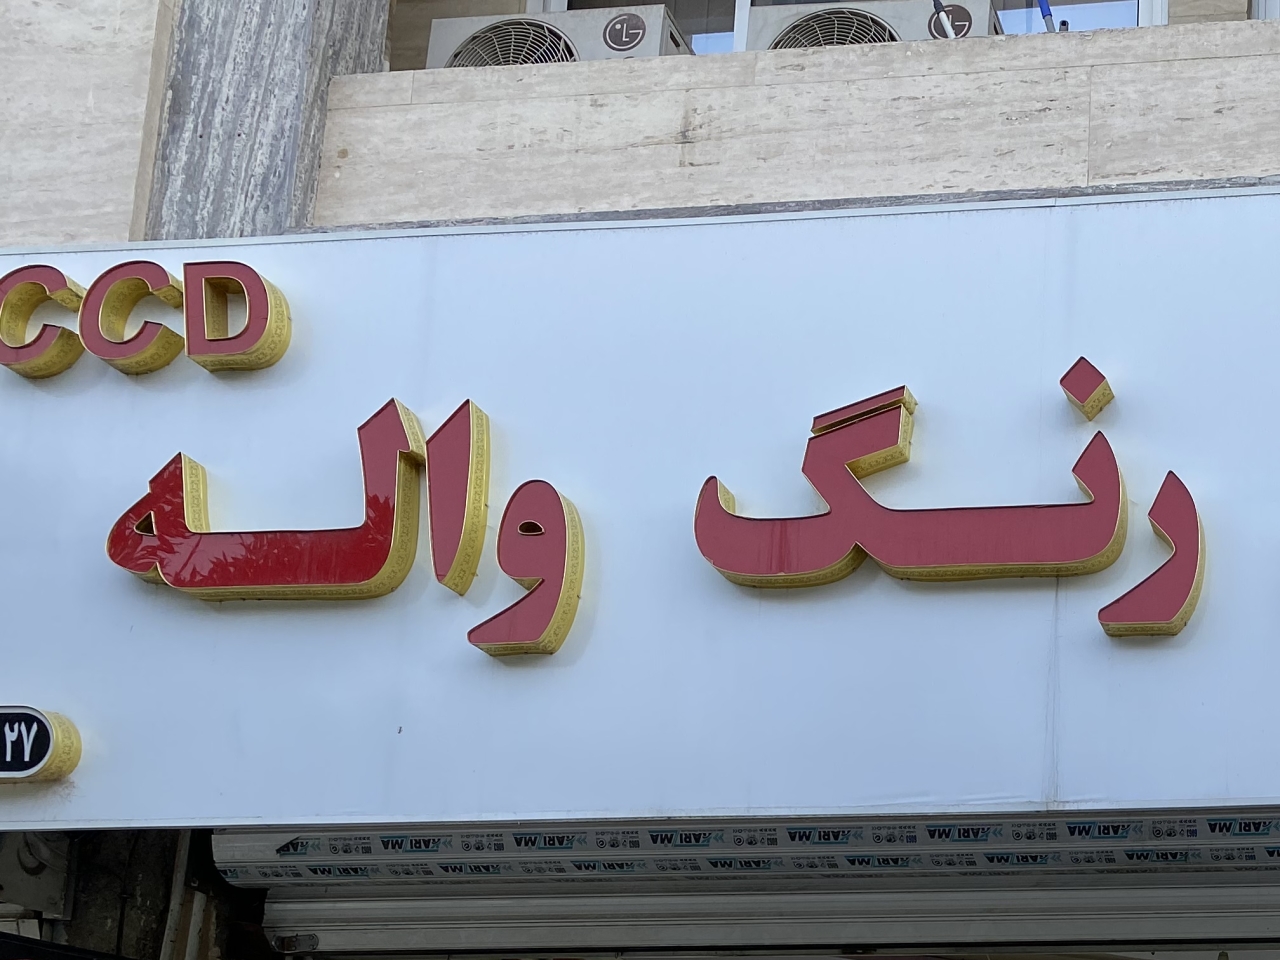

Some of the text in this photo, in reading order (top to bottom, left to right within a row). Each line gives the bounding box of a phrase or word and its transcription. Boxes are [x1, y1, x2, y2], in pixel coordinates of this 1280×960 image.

[0, 259, 291, 378] CCD
[106, 397, 585, 656] واله
[694, 356, 1206, 636] رنگ
